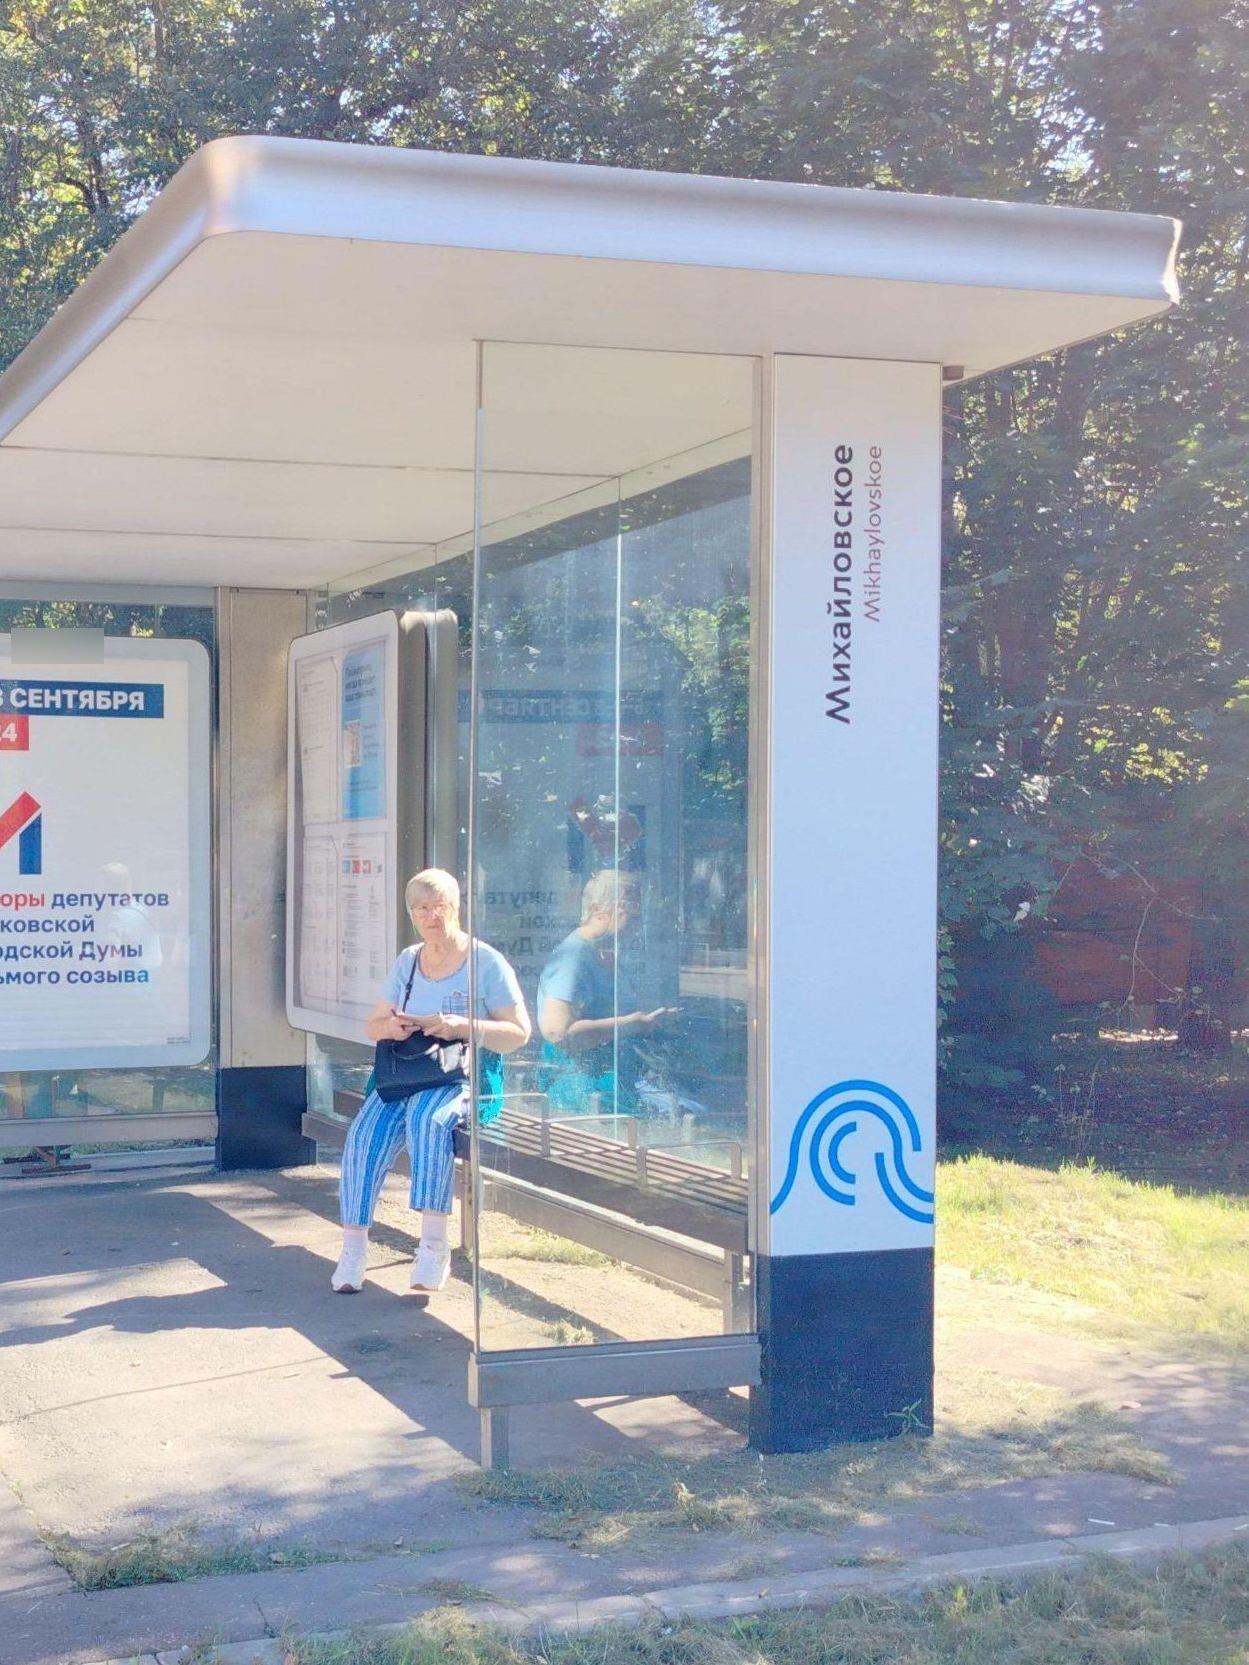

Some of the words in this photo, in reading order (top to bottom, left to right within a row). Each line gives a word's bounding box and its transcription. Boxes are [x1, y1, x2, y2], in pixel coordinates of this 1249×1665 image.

[864, 446, 885, 623] Mikhaylovskoe
[825, 445, 853, 724] Михайловское
[9, 687, 145, 711] СЕНТЯБРЯ
[51, 892, 170, 912] депутатов
[79, 940, 143, 963] Думы
[66, 969, 150, 985] созыва
